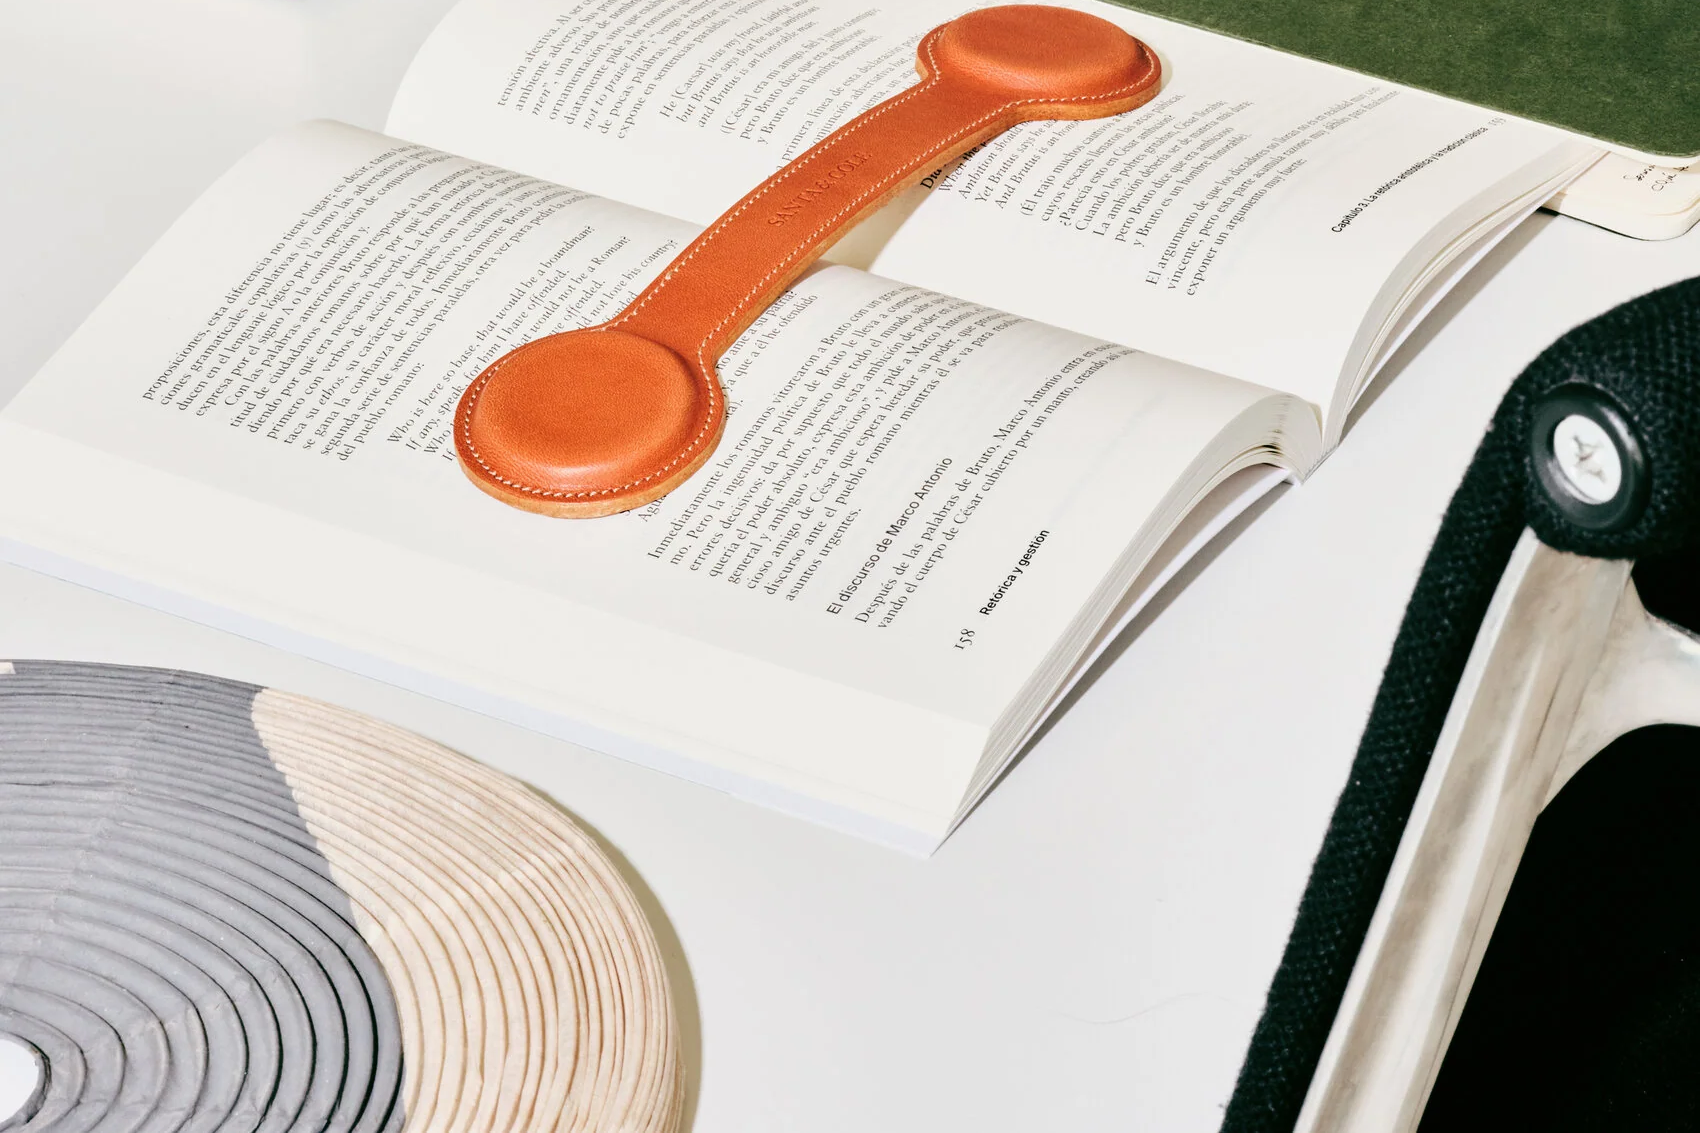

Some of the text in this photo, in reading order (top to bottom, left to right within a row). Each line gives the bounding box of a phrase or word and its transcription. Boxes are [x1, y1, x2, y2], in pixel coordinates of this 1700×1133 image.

[497, 65, 527, 106] tensión
[524, 27, 560, 63] afectiva.
[515, 60, 550, 111] ambiente
[548, 25, 584, 58] adverso.
[675, 56, 739, 122] but Brutus says
[698, 105, 715, 128] and
[709, 75, 741, 105] Brutus
[768, 189, 823, 228] SANTA
[828, 152, 872, 180] COLE
[994, 183, 1016, 209] And
[1009, 154, 1040, 184] Brutus
[1046, 136, 1059, 147] an
[1033, 175, 1055, 198] trajo
[1160, 197, 1173, 207] es
[1169, 180, 1184, 197] un
[1331, 204, 1363, 232] Capítulo
[1358, 198, 1370, 208] 3.
[1365, 194, 1378, 203] La
[1133, 238, 1145, 247] y
[1135, 208, 1163, 236] Bruto
[1145, 270, 1161, 285] El
[1157, 212, 1198, 269] argumento
[1193, 200, 1209, 211] de
[1167, 239, 1204, 289] vincente,
[1198, 214, 1219, 237] pero
[1216, 196, 1236, 213] esta
[1186, 247, 1217, 296] exponer
[1214, 231, 1229, 245] un
[1225, 188, 1267, 230] argumento
[142, 165, 371, 400] proposiciones, esta diferencia no tiene lugar; es decir,
[224, 384, 250, 406] Con
[242, 368, 264, 383] las
[260, 324, 301, 367] palabras
[299, 275, 344, 322] anteriores
[338, 246, 370, 273] Bruto
[368, 208, 410, 246] responde
[386, 419, 414, 442] Who
[410, 407, 424, 417] is
[417, 383, 444, 406] here
[442, 369, 456, 382] so
[449, 344, 480, 368] base,
[475, 320, 498, 341] that
[495, 287, 526, 319] would
[519, 276, 538, 288] be
[537, 268, 546, 277] a
[405, 437, 422, 450] If
[419, 418, 441, 439] any,
[464, 362, 483, 383] for
[476, 343, 501, 363] him
[501, 311, 528, 335] have
[527, 269, 569, 310] offended.
[336, 362, 424, 461] del pueblo romano:
[647, 471, 723, 558] Inmediatamente
[715, 453, 738, 469] los
[734, 406, 775, 451] romanos
[772, 354, 820, 403] vitorearon
[820, 322, 852, 345] Bruto
[849, 305, 869, 322] con
[727, 542, 762, 584] general
[759, 532, 772, 542] y
[768, 483, 808, 531] ambiguo
[882, 365, 904, 386] pide
[906, 331, 941, 357] Marco
[764, 549, 805, 595] discurso
[804, 521, 827, 546] ante
[824, 506, 837, 518] el
[835, 467, 867, 505] pueblo
[865, 423, 901, 464] romano
[899, 379, 940, 420] mientras
[936, 367, 950, 377] él
[947, 357, 961, 367] se
[958, 347, 974, 356] va
[854, 579, 897, 623] Después
[893, 561, 909, 576] de
[903, 543, 924, 559] las
[921, 495, 959, 541] palabras
[955, 478, 971, 492] de
[965, 444, 1001, 475] Bruto,
[992, 409, 1028, 441] Marco
[1023, 374, 1062, 407] Antonio
[877, 595, 907, 628] vando
[904, 582, 918, 593] el
[915, 543, 947, 581] cuerpo
[941, 527, 959, 541] de
[953, 493, 983, 524] César
[981, 449, 1018, 491] cubierto
[1015, 429, 1033, 448] por
[1030, 415, 1047, 428] un
[1043, 386, 1079, 414] manto,
[785, 508, 861, 601] asuntos urgentes.
[826, 458, 952, 615] El discurso de Marco Antonio
[954, 530, 1049, 650] 158 Retórica y gestión
